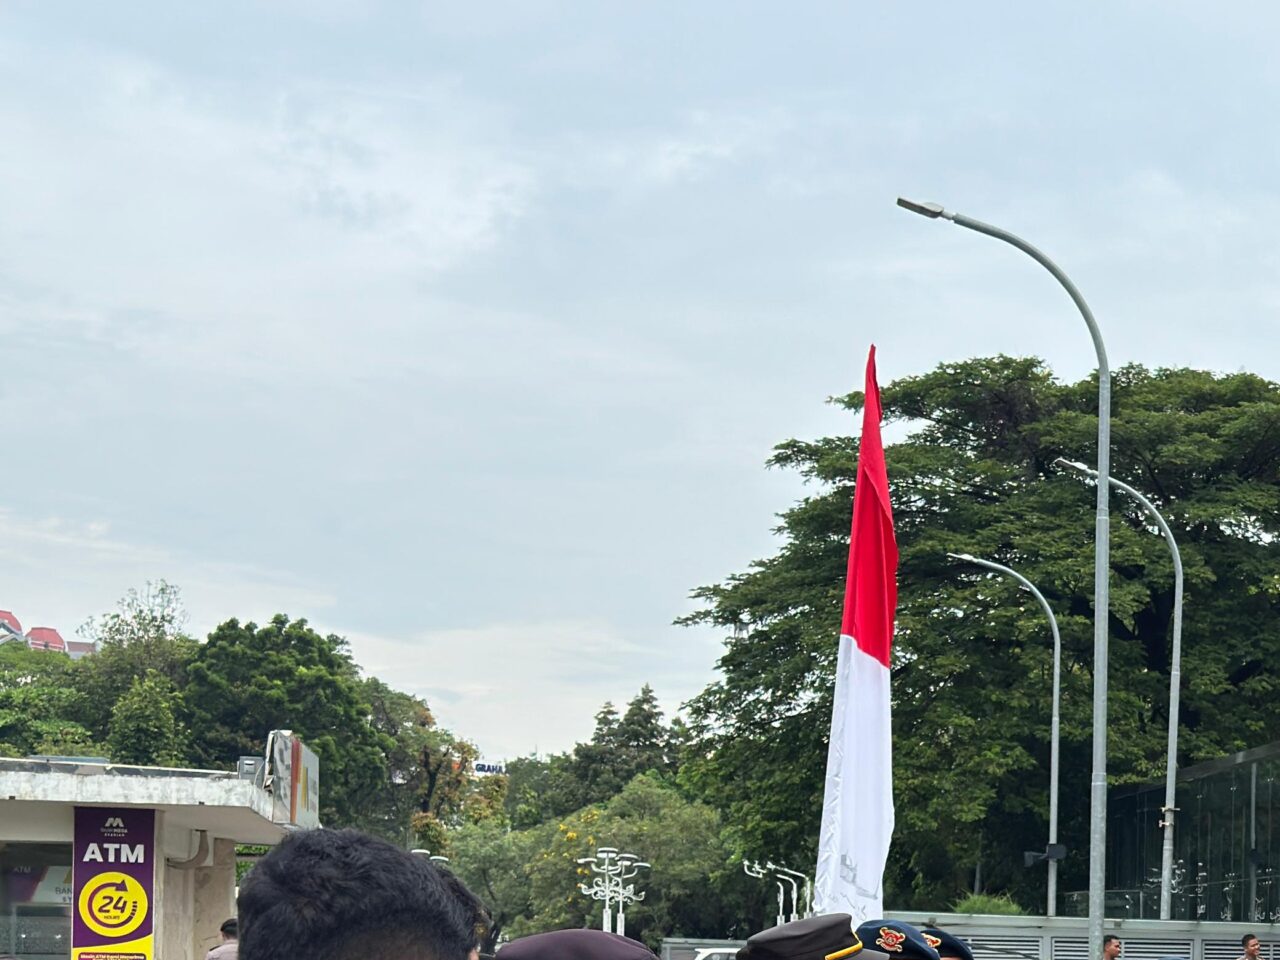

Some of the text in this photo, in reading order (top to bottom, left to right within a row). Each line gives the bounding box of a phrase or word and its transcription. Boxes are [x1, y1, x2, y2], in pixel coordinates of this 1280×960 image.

[475, 763, 503, 774] GRAHA
[82, 843, 145, 863] ATM
[97, 895, 128, 914] 24
